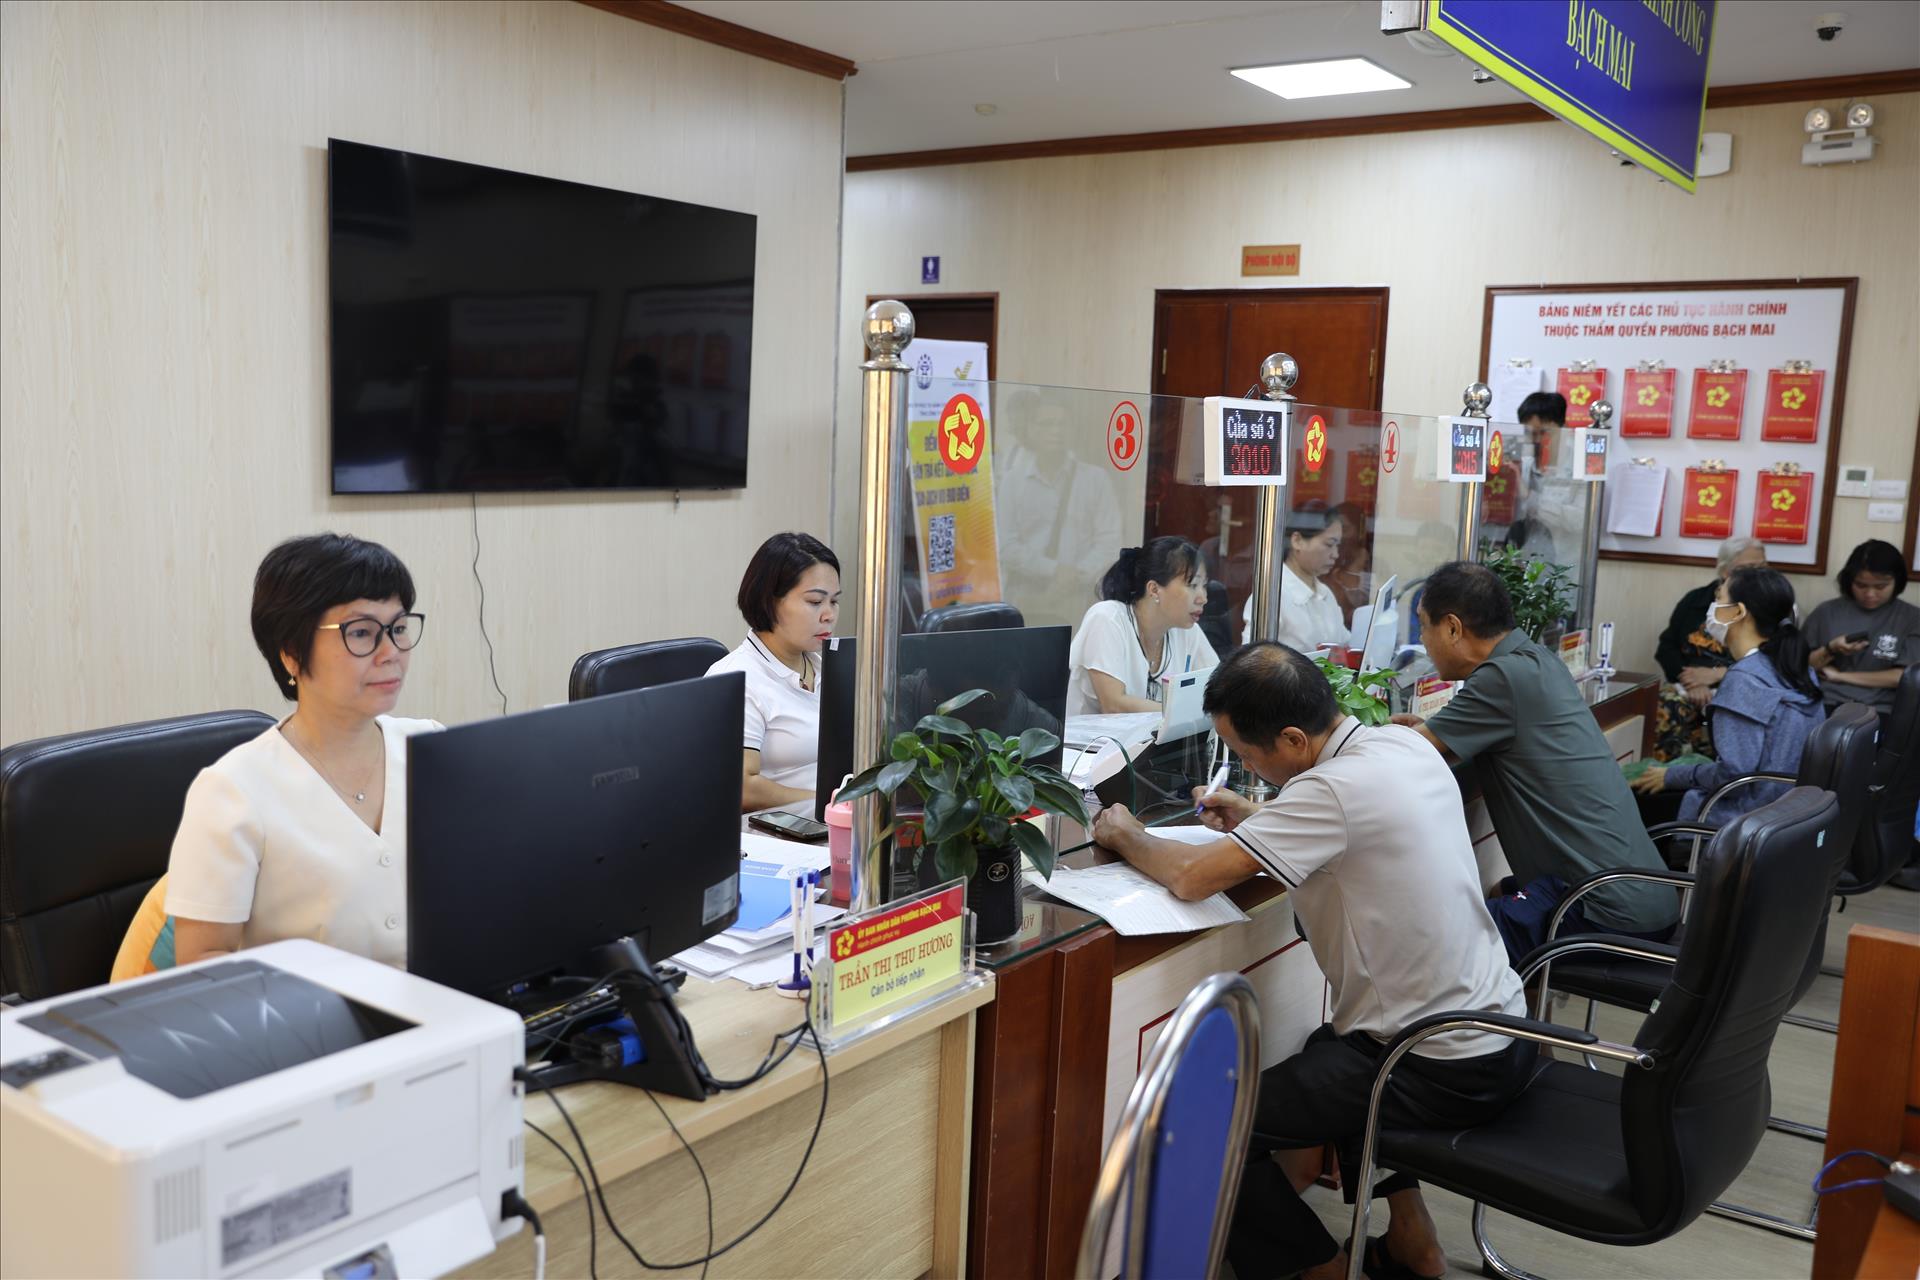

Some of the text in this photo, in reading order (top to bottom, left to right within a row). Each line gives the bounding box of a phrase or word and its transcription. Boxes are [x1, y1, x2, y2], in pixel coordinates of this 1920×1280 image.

[1566, 0, 1608, 71] BẠCH
[1605, 24, 1635, 91] MAI
[1539, 301, 1569, 317] BẢNG
[1629, 302, 1653, 317] CÁC
[1747, 300, 1788, 316] CHÍNH
[1712, 323, 1746, 340] BẠCH
[1750, 323, 1776, 337] MAI
[1114, 413, 1136, 460] 3
[1227, 410, 1275, 440] Cửa số 3
[1474, 429, 1481, 448] 4
[1231, 444, 1271, 476] 3010
[1384, 430, 1397, 464] 4
[839, 932, 953, 991] TRẦN THỊ THU HƯƠNG
[870, 983, 885, 998] Cán
